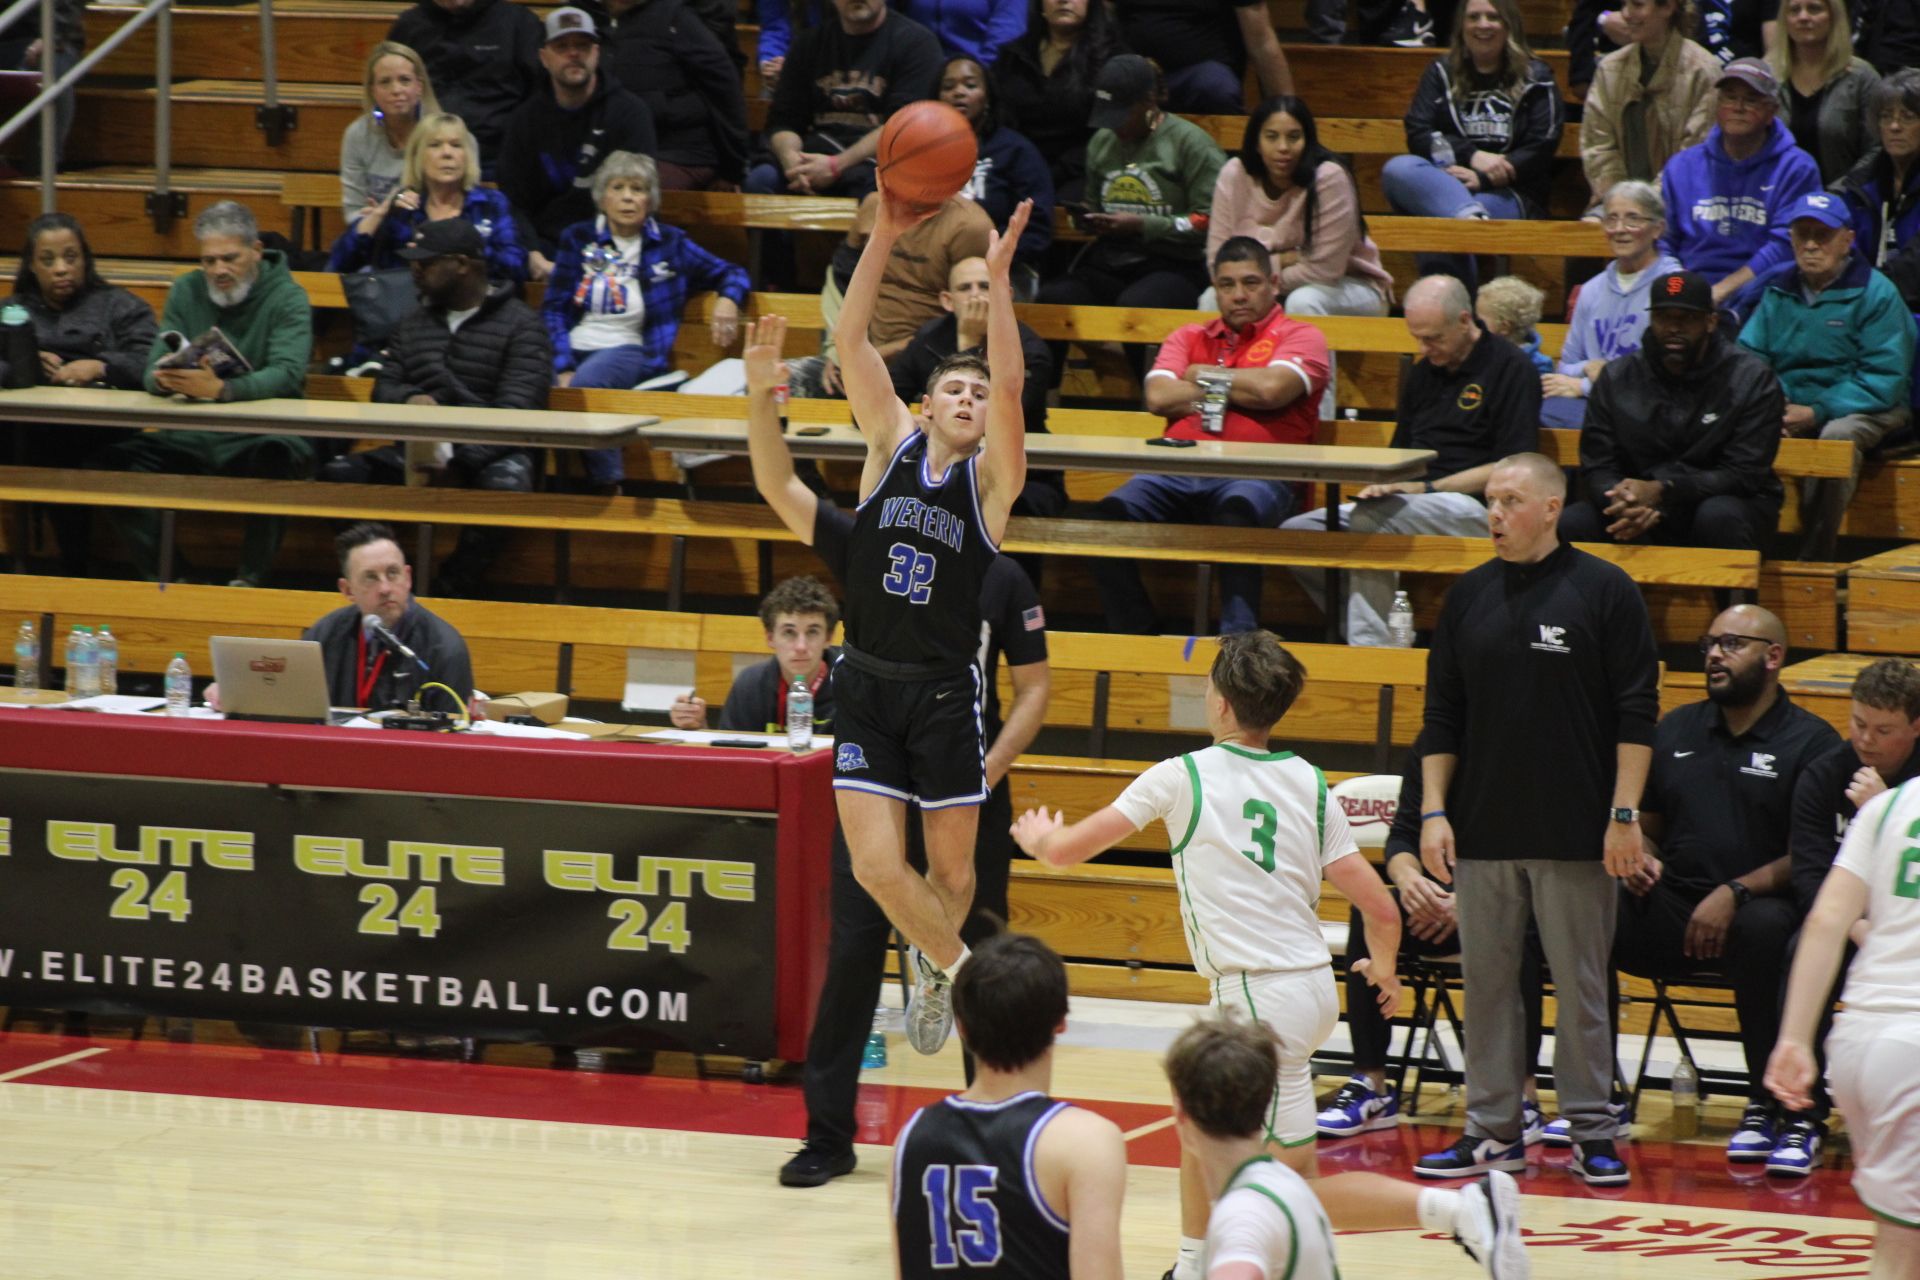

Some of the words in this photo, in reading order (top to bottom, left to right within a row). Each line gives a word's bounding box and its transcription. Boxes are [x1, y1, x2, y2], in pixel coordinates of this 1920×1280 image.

[879, 496, 964, 553] WESTERN
[883, 542, 936, 604] 32
[1539, 624, 1566, 645] WC
[46, 819, 255, 871] ELITE
[293, 834, 505, 886] ELITE
[1241, 798, 1278, 873] 3
[109, 867, 192, 923] 24
[543, 849, 755, 902] ELITE
[358, 883, 441, 938] 24
[607, 898, 691, 954] 24
[922, 1164, 1003, 1269] 15
[1560, 1214, 1877, 1250] OURT
